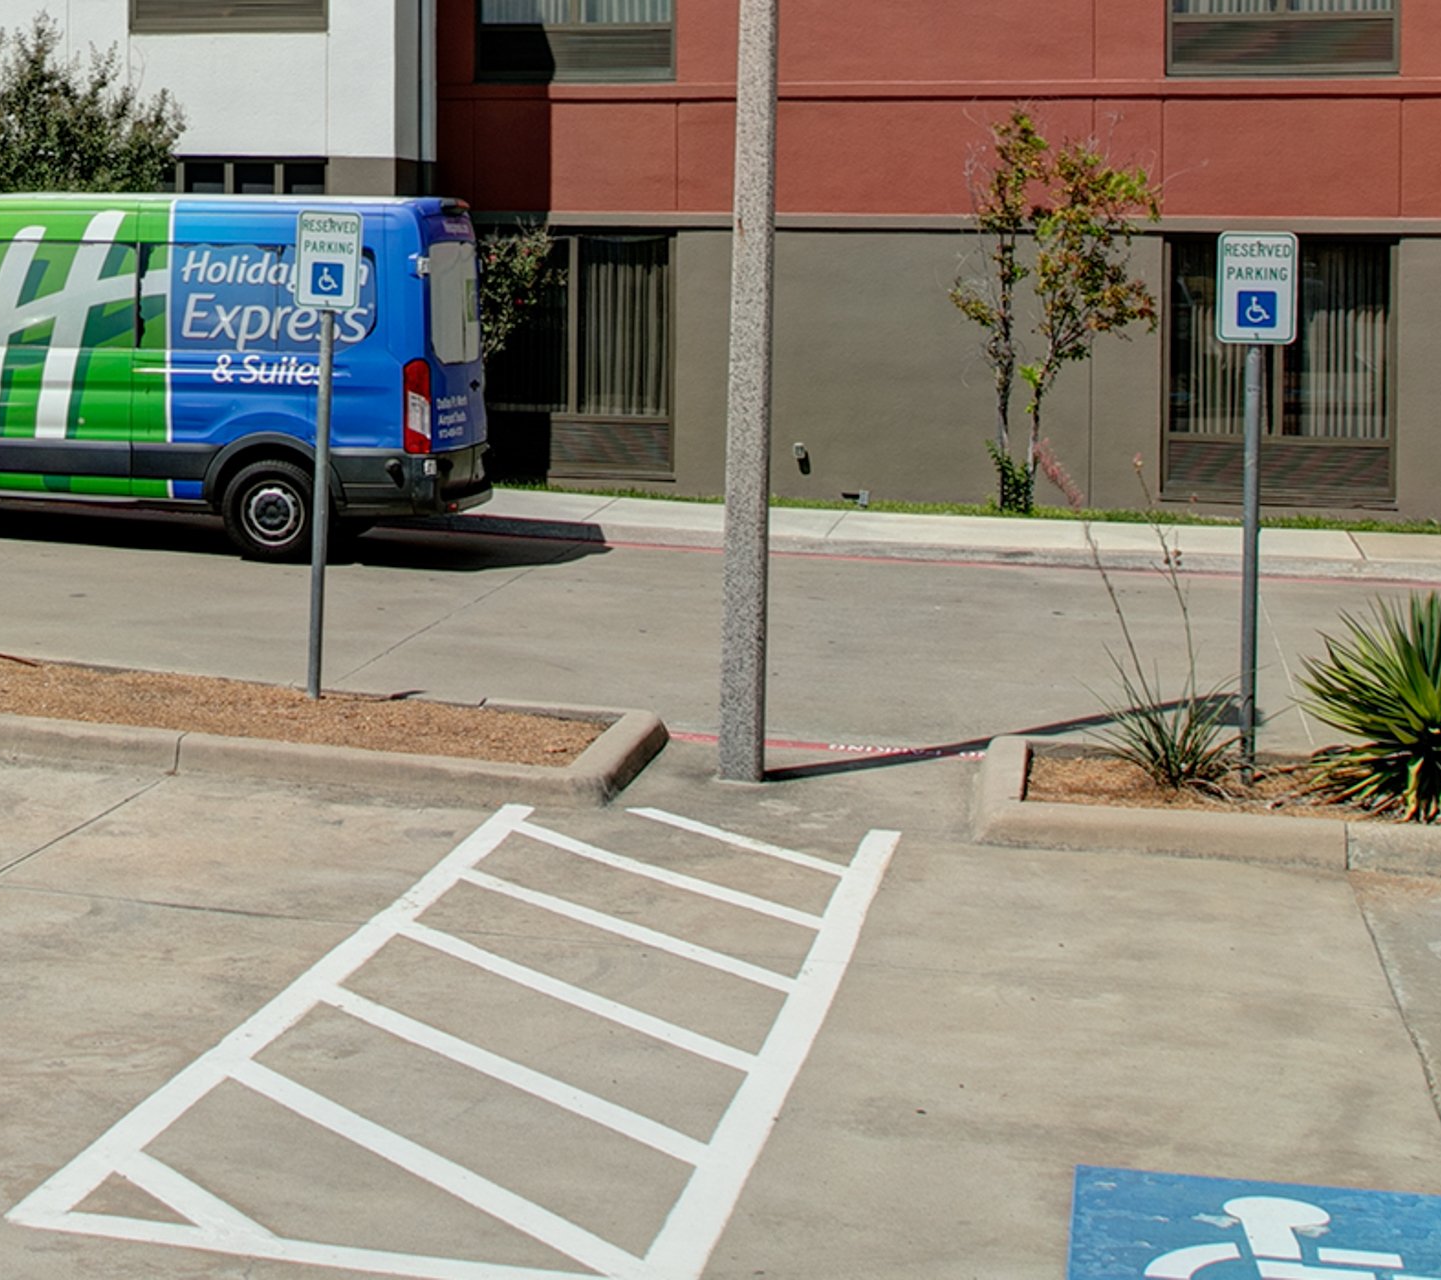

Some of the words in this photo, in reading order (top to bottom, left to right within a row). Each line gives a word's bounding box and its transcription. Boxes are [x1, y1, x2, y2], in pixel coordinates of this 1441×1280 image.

[301, 219, 359, 235] RESERVED
[304, 240, 355, 255] PARKING
[1224, 243, 1293, 258] RESERVED
[1226, 266, 1289, 282] PARKING
[212, 354, 234, 384] &
